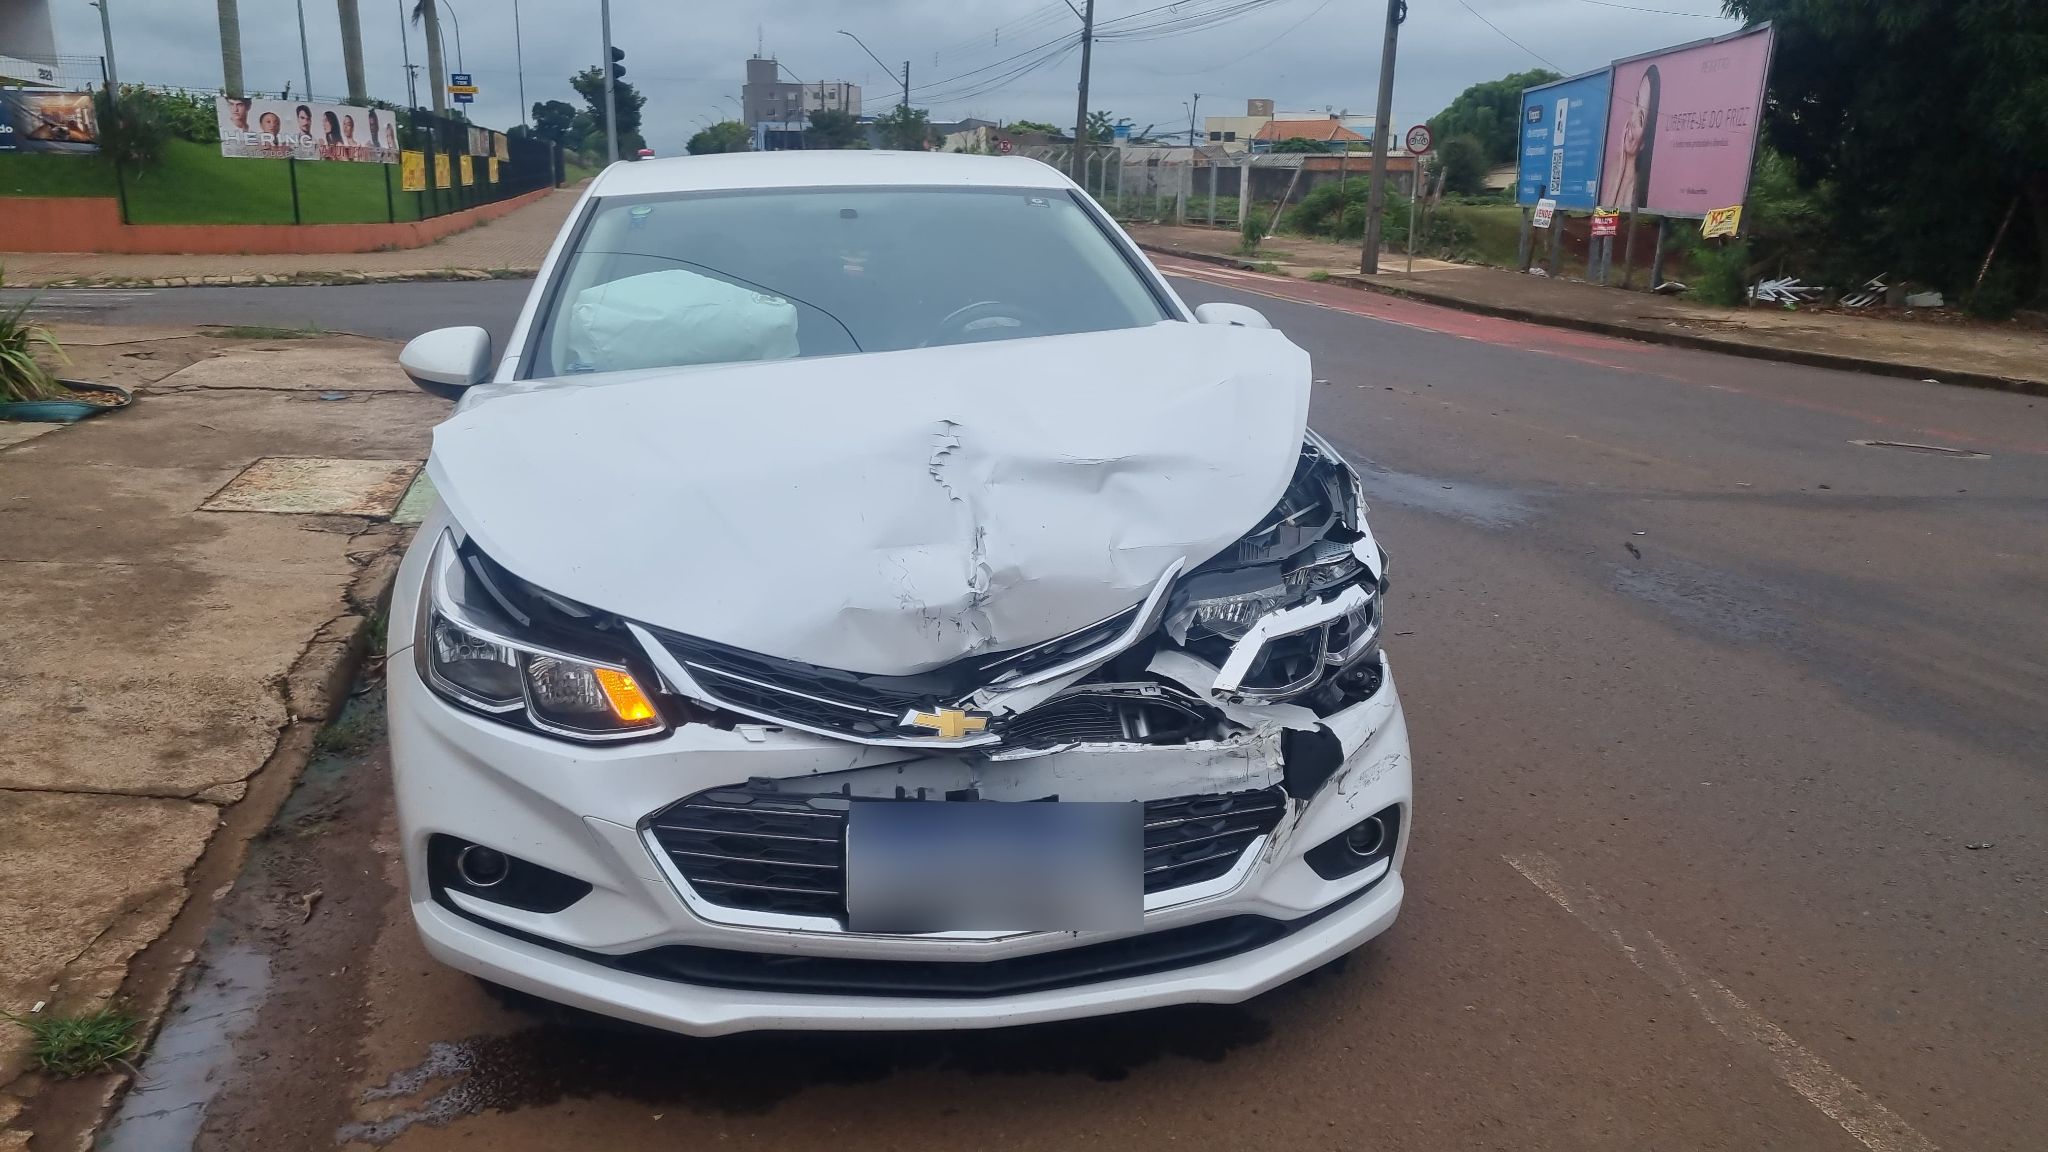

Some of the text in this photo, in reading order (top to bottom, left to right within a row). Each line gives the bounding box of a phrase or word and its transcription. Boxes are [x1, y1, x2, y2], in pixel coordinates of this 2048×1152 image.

[1709, 109, 1723, 128] DO
[223, 130, 313, 148] HERING
[1536, 208, 1553, 219] VENDE
